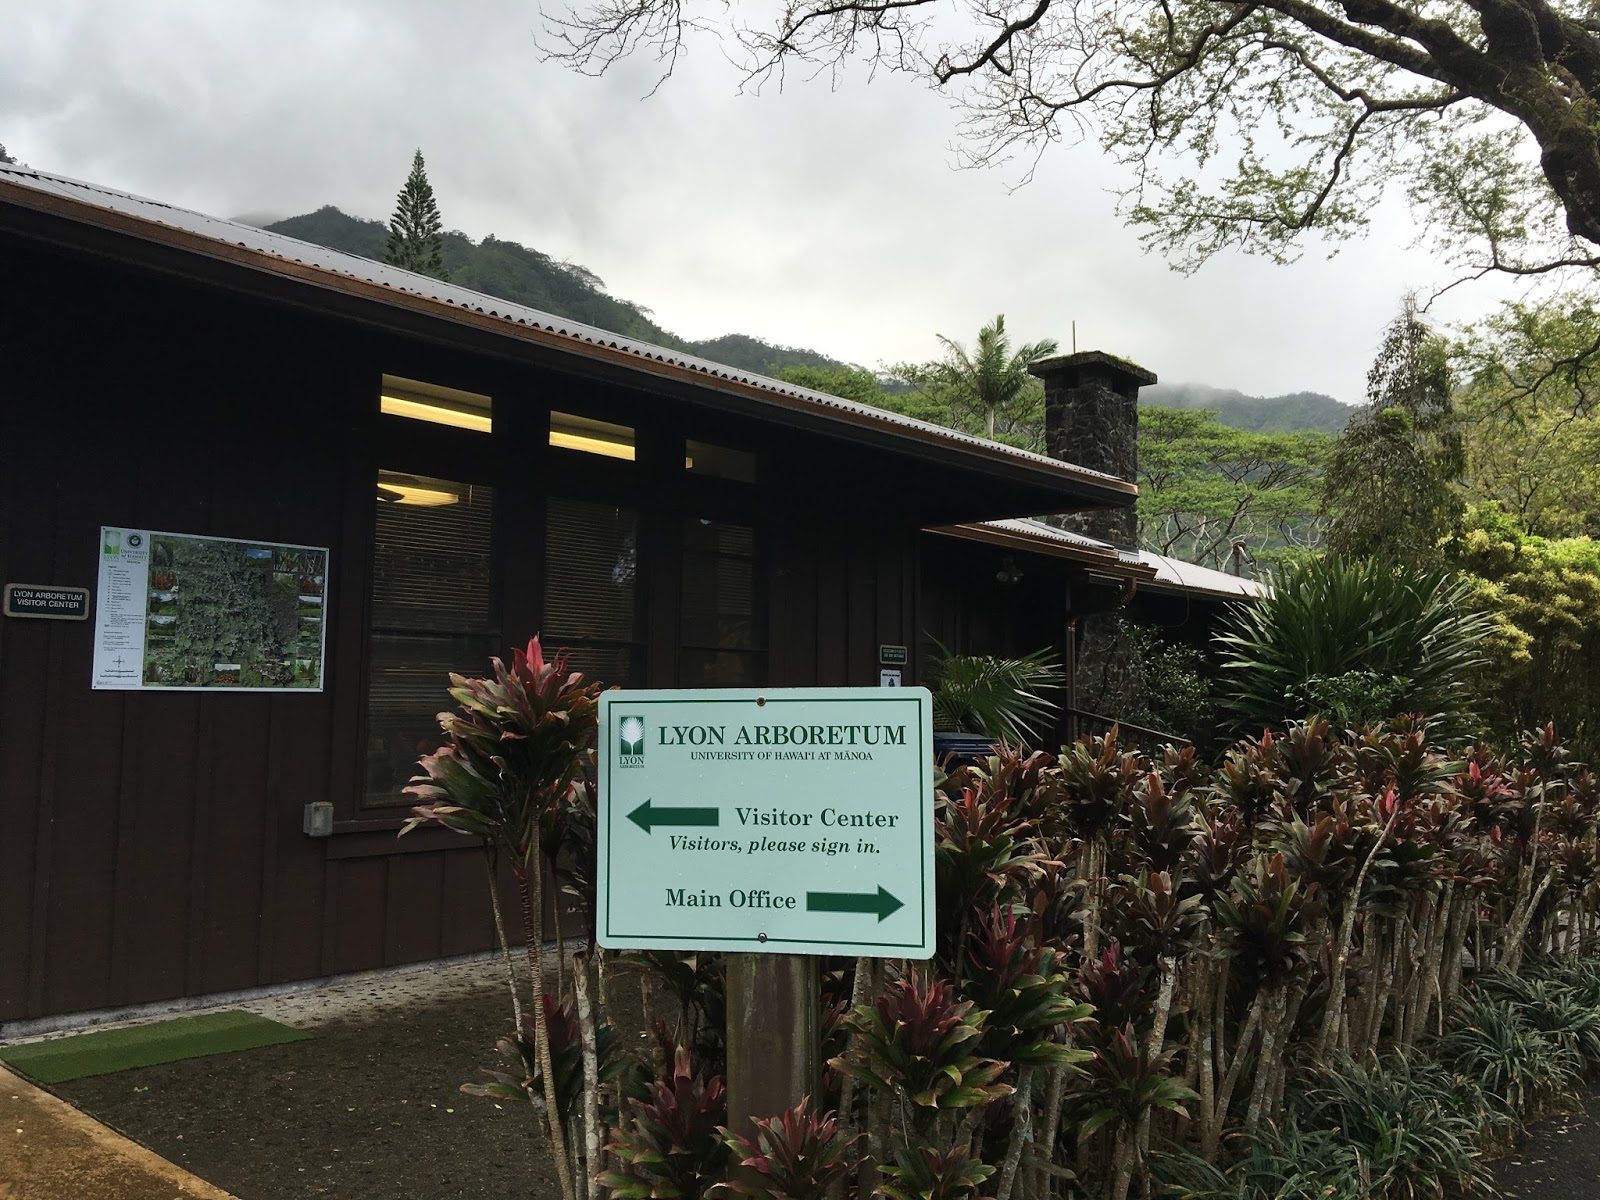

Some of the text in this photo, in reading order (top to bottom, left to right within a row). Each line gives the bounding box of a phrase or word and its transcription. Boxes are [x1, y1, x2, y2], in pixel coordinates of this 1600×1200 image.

[13, 590, 83, 601] LYON ARBORETUM
[16, 598, 79, 609] VISITOR CENTER
[657, 725, 907, 746] LYON ARBORETUM
[619, 756, 645, 765] LYON
[690, 751, 755, 761] UNIVERSITY
[757, 751, 772, 760] OF
[817, 751, 832, 761] AT
[834, 750, 873, 761] MĀNOA
[735, 807, 899, 828] Visitor Center
[669, 835, 880, 856] Visitors, please sign in.
[665, 888, 797, 910] Main Office
